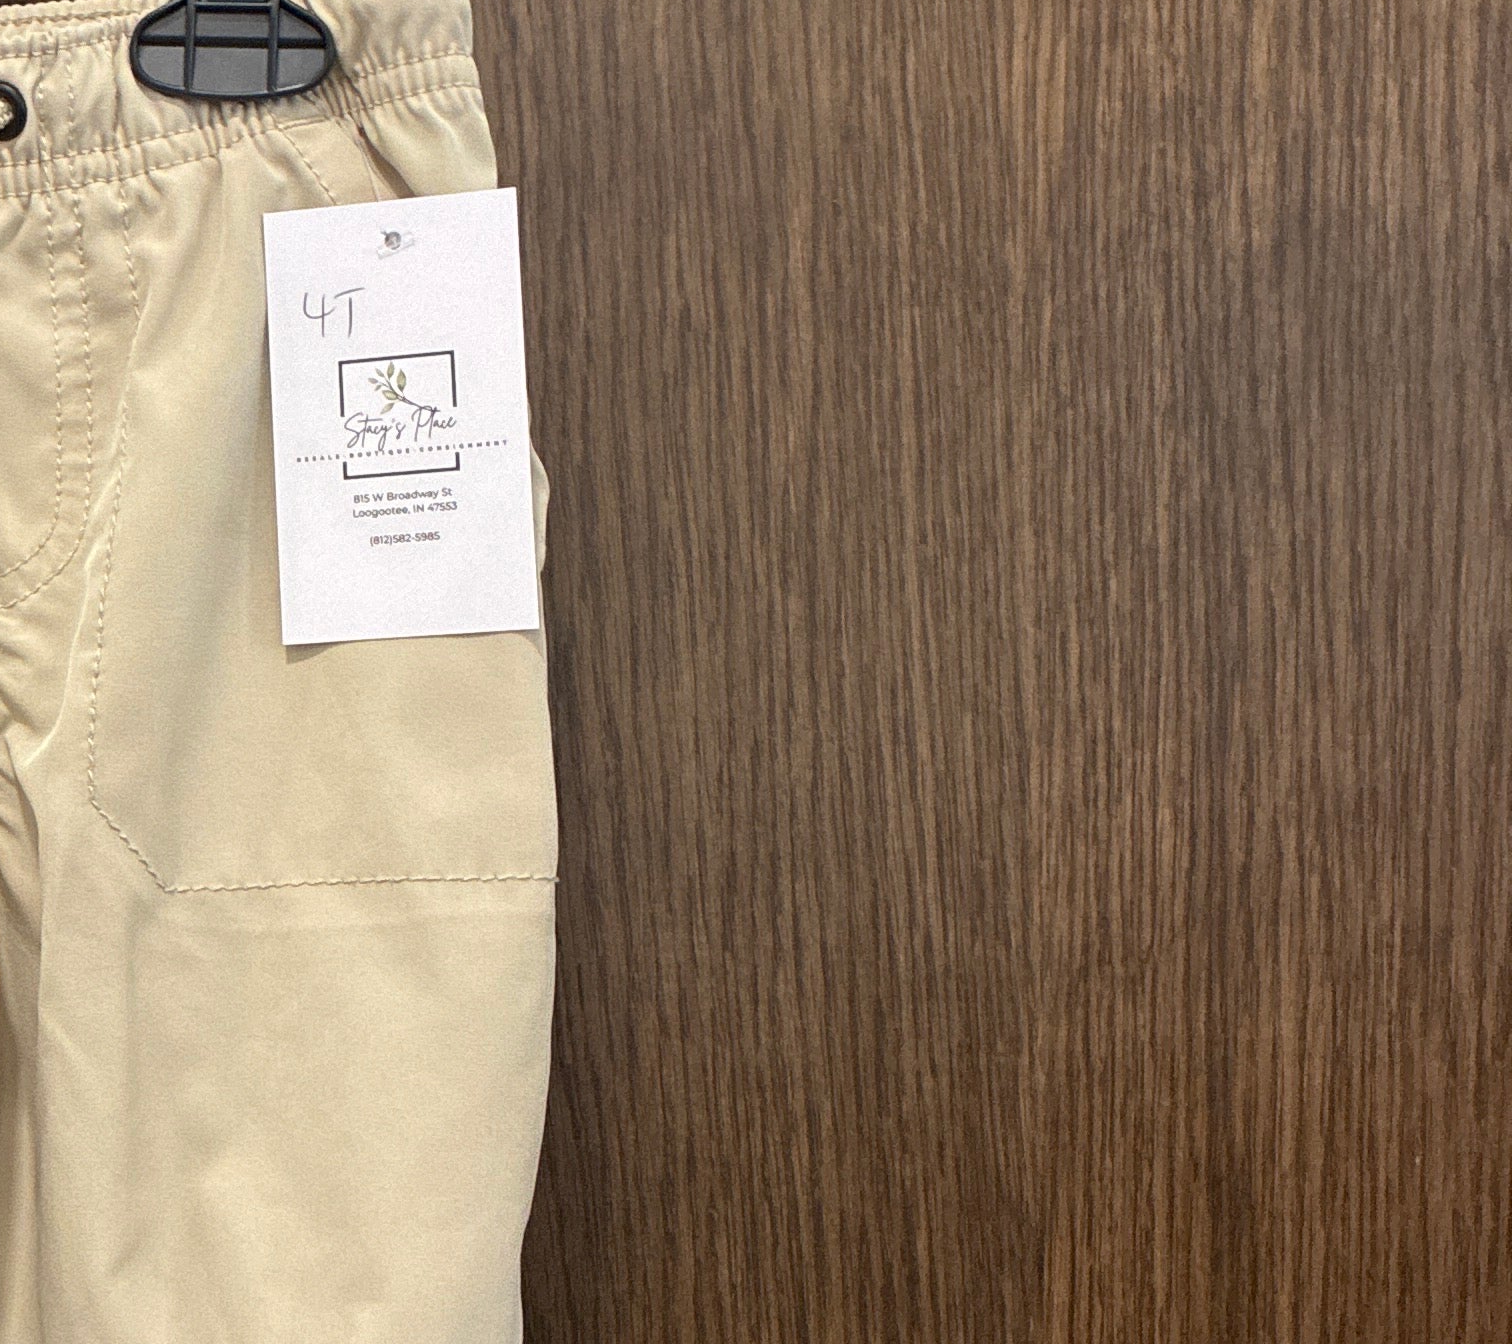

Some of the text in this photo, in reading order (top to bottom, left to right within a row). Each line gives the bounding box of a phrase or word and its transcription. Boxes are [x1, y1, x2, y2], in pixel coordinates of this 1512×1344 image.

[302, 287, 366, 338] 4T
[344, 405, 457, 452] Stacy's Place
[353, 487, 453, 504] 815 W Broadway St
[352, 500, 458, 519] Loogootee, IN 47553
[369, 531, 441, 547] (812)582-5985
